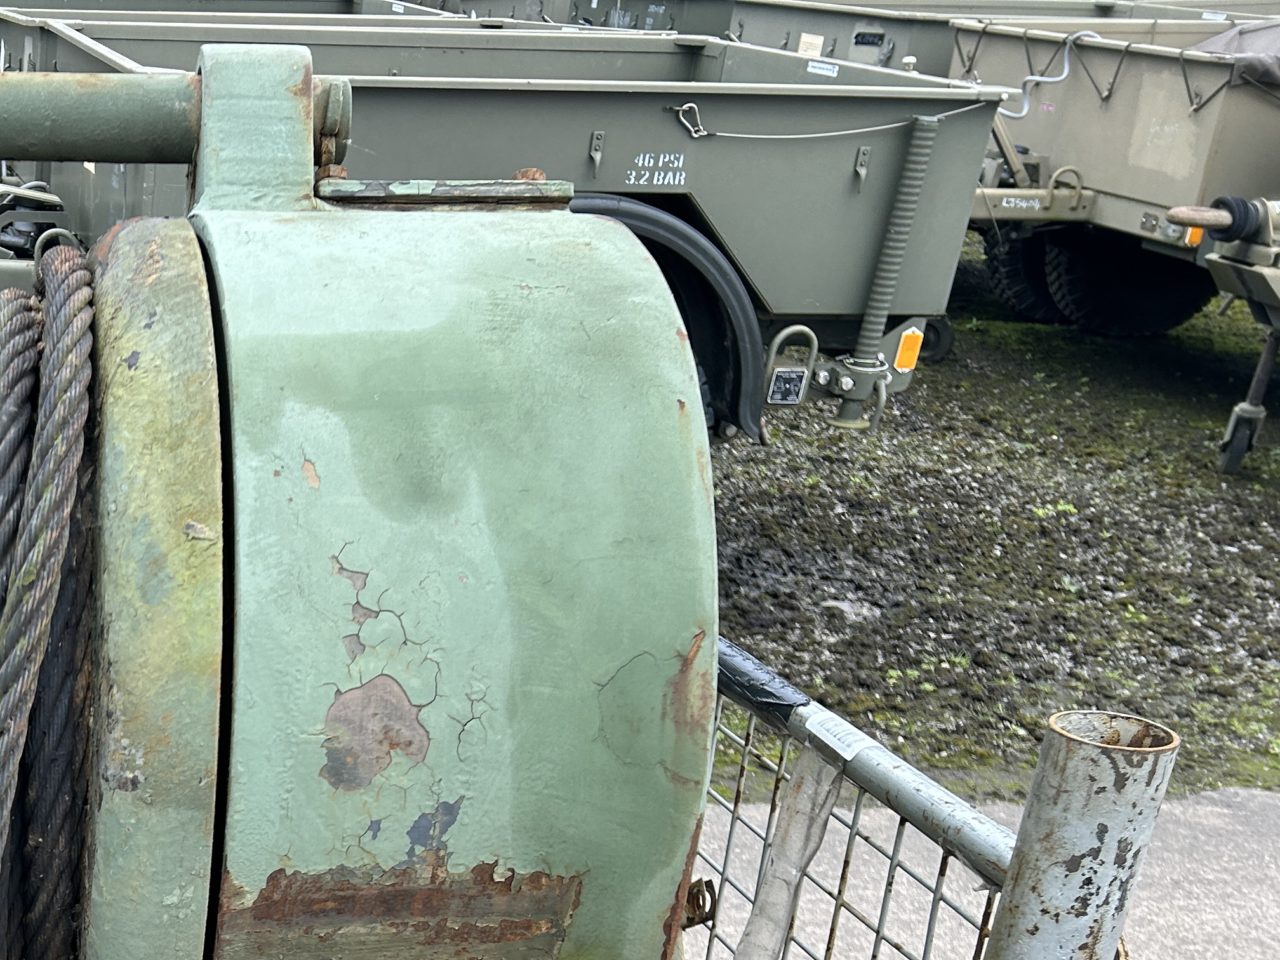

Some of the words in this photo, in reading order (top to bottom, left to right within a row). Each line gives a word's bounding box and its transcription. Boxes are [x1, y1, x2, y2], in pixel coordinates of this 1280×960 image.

[634, 153, 655, 167] 46
[658, 153, 684, 168] PSI
[625, 170, 650, 185] 3.2
[653, 170, 686, 186] BAR
